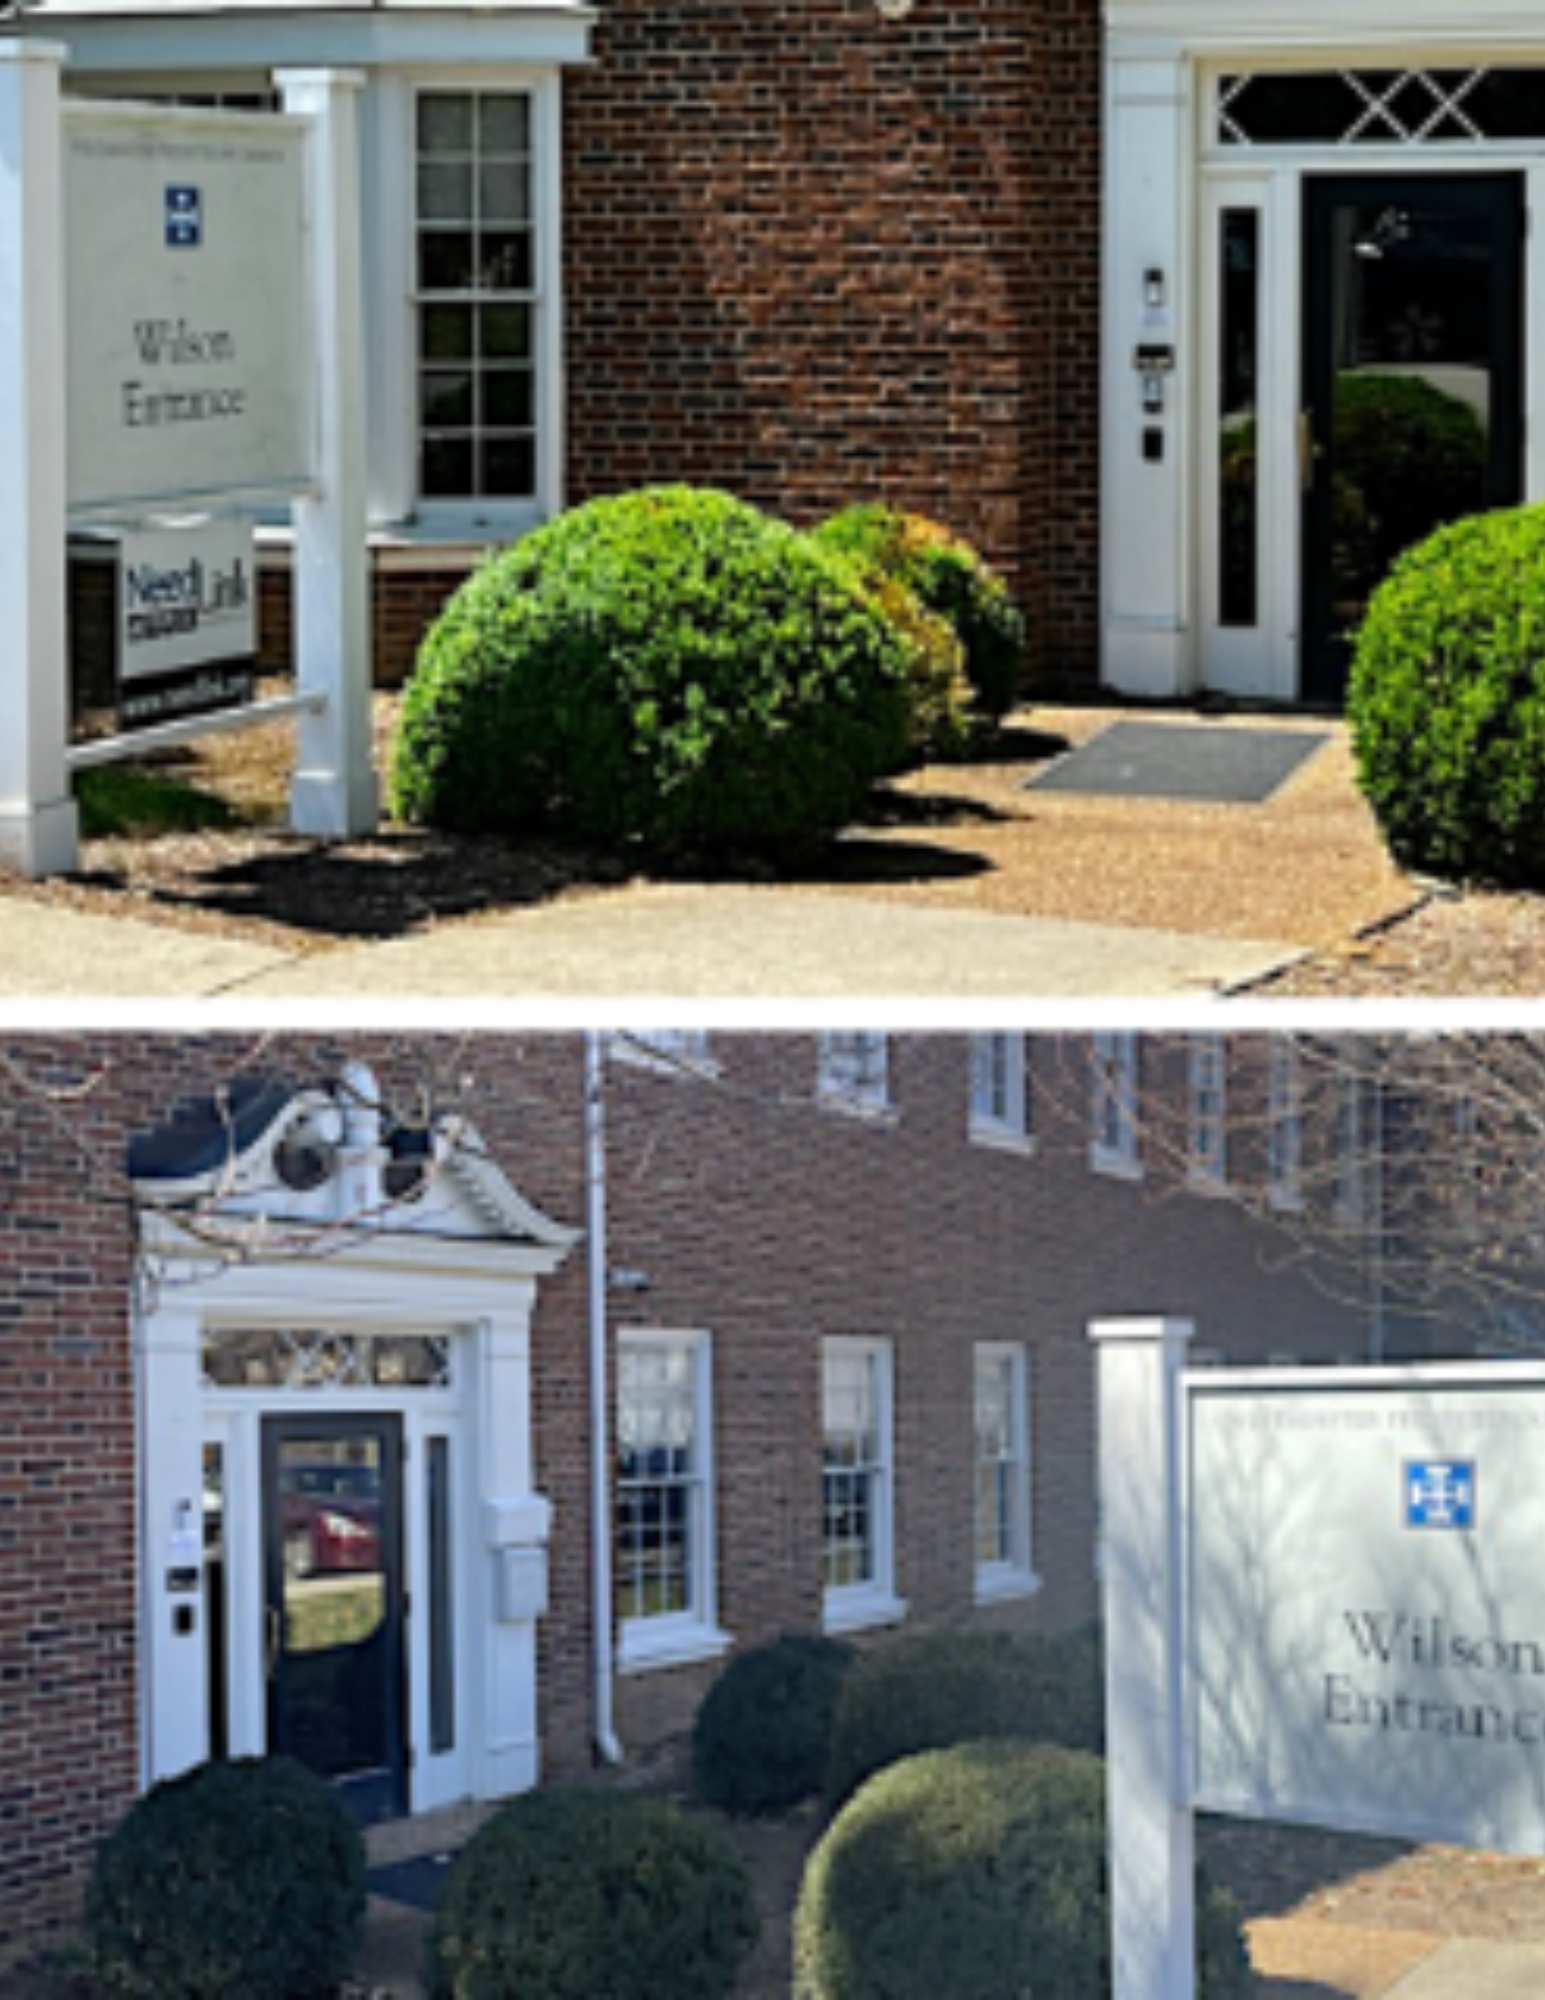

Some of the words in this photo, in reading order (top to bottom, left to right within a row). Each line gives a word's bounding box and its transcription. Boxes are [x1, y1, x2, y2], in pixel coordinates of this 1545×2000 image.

[134, 318, 235, 364] Wilson
[121, 380, 244, 426] Entrance
[1343, 1610, 1545, 1675] Wilson
[1325, 1673, 1545, 1743] Entranc
